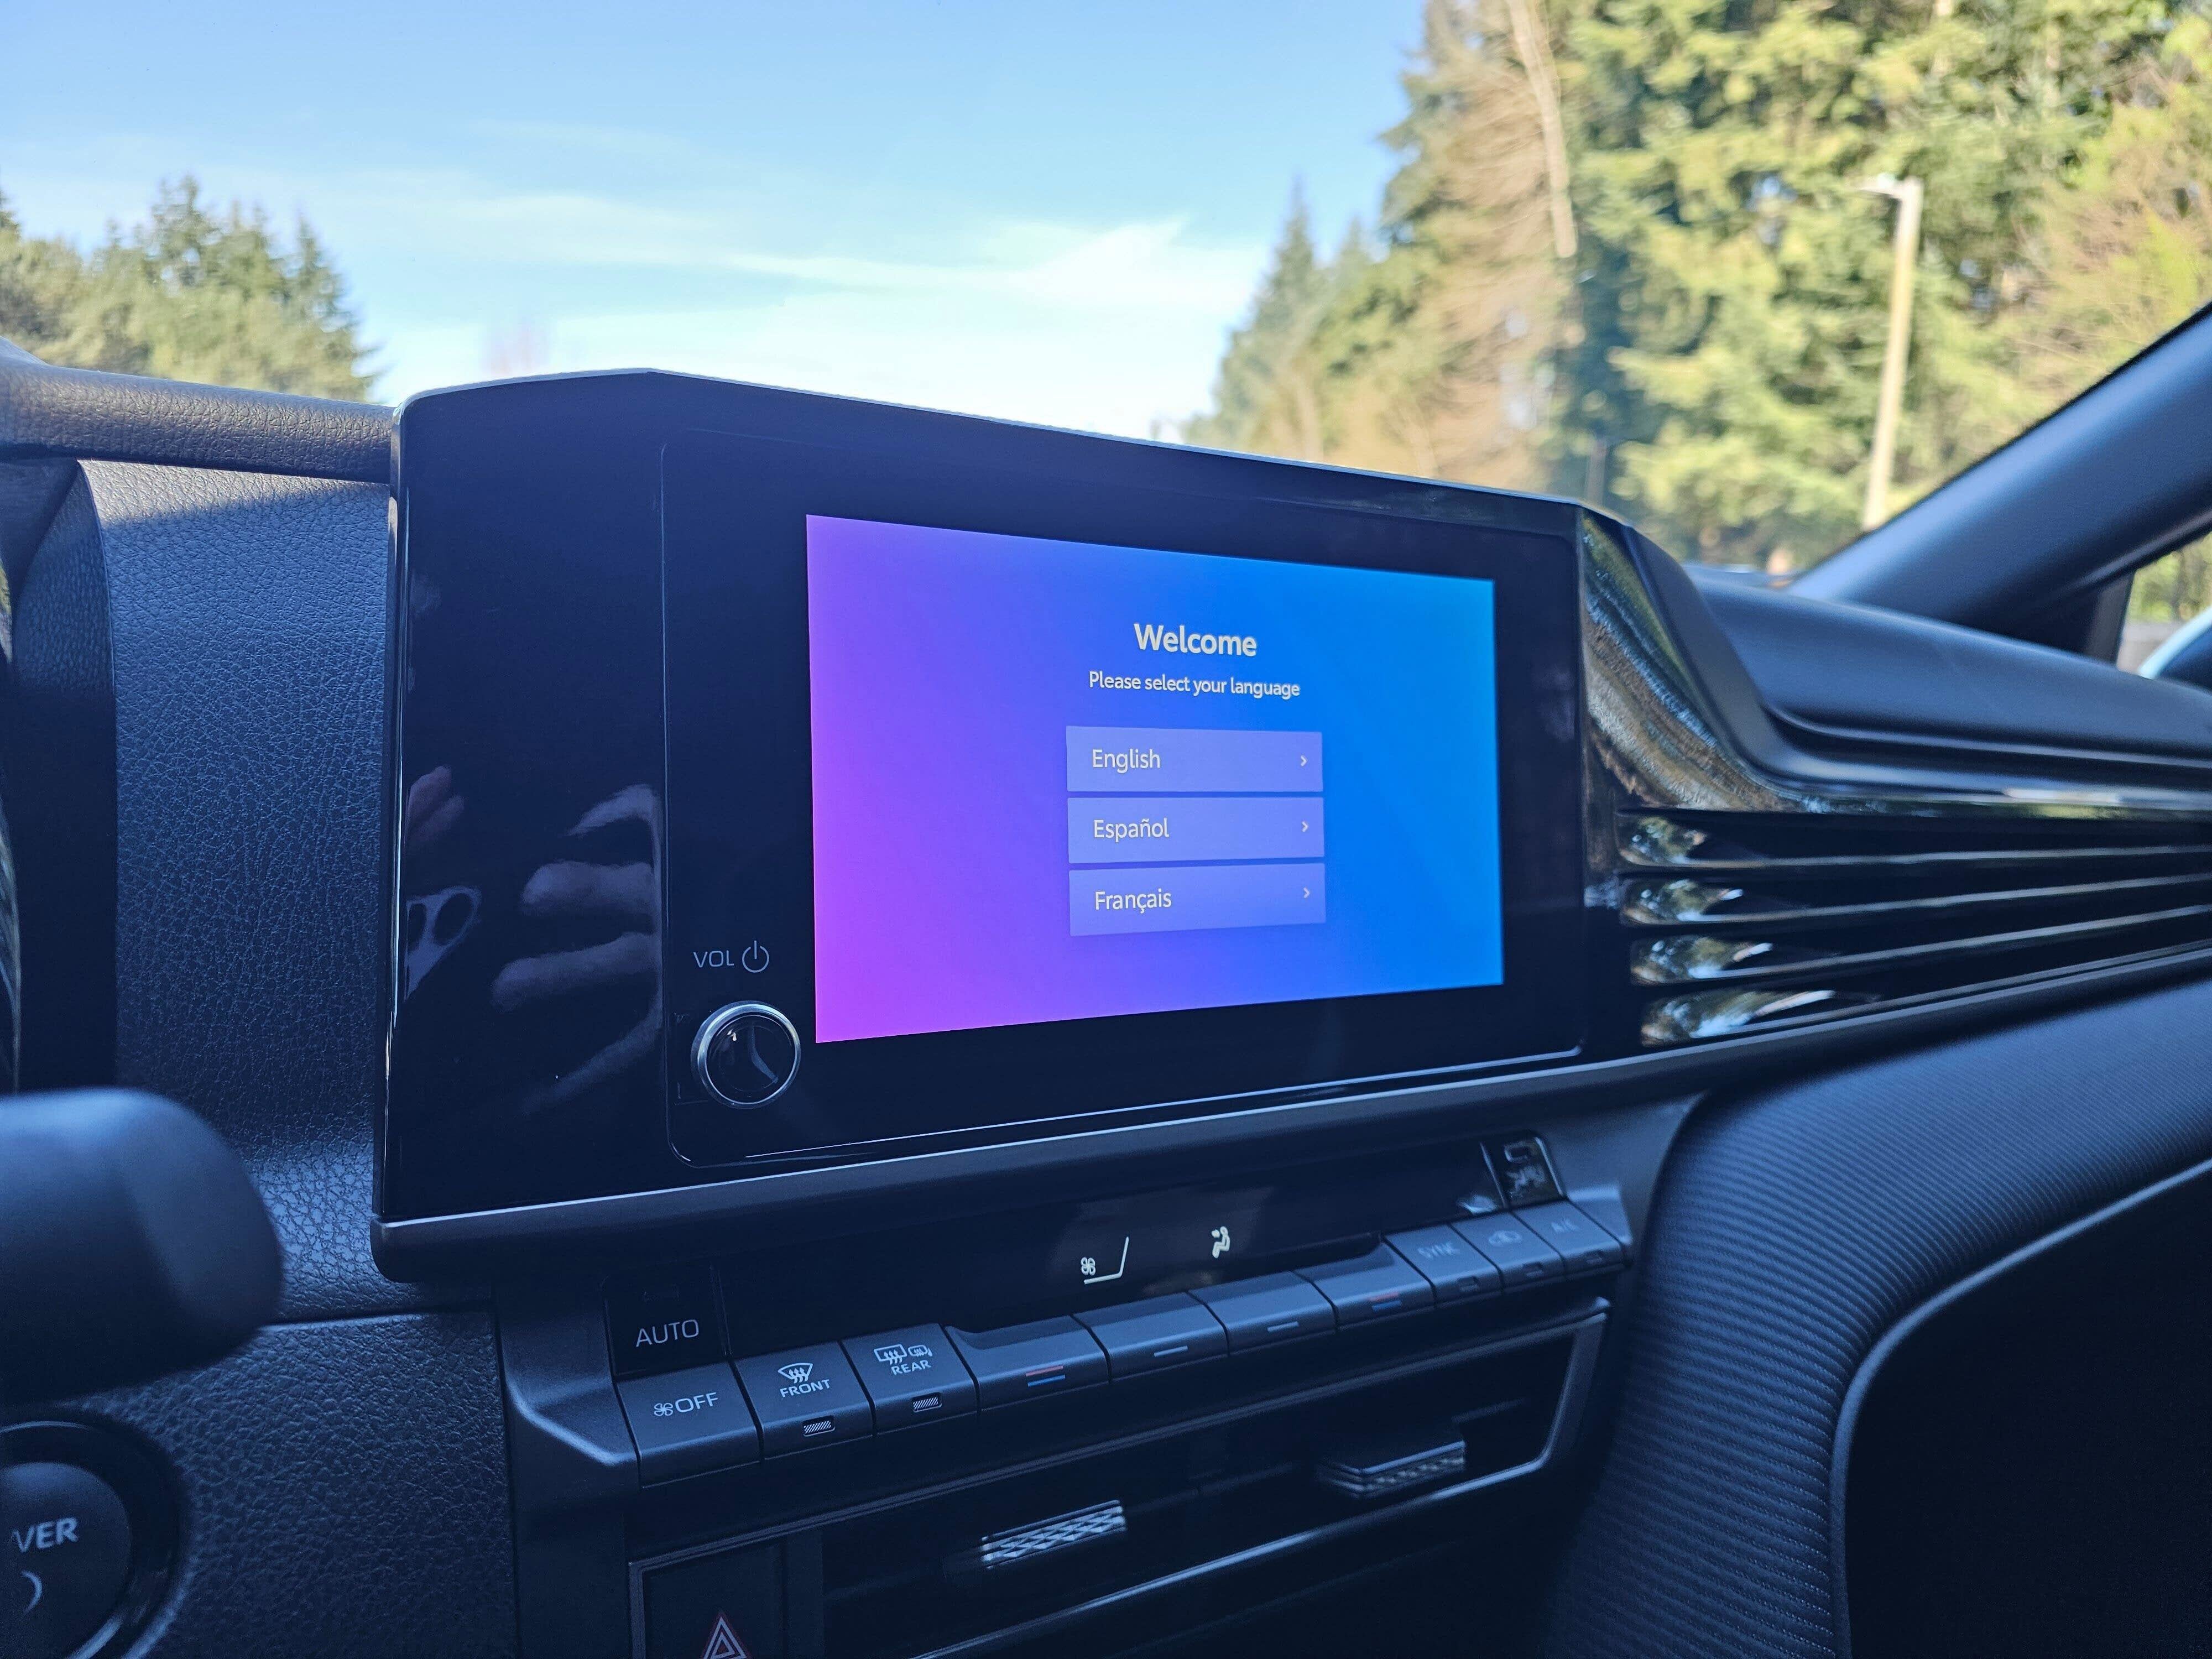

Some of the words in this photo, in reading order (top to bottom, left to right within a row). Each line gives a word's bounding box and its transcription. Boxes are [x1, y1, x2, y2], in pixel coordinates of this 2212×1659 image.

[1134, 623, 1258, 657] Welcome
[1089, 671, 1141, 691] Please
[1145, 674, 1191, 692] select
[1193, 680, 1227, 696] your
[1230, 677, 1301, 700] language
[1092, 748, 1161, 774] English
[1093, 817, 1170, 843] Español
[1095, 888, 1172, 914] Français
[693, 950, 734, 968] VOL
[635, 1319, 700, 1348] AUTO
[891, 1359, 932, 1375] REAR
[780, 1379, 831, 1397] FRONT
[675, 1391, 719, 1413] OFF
